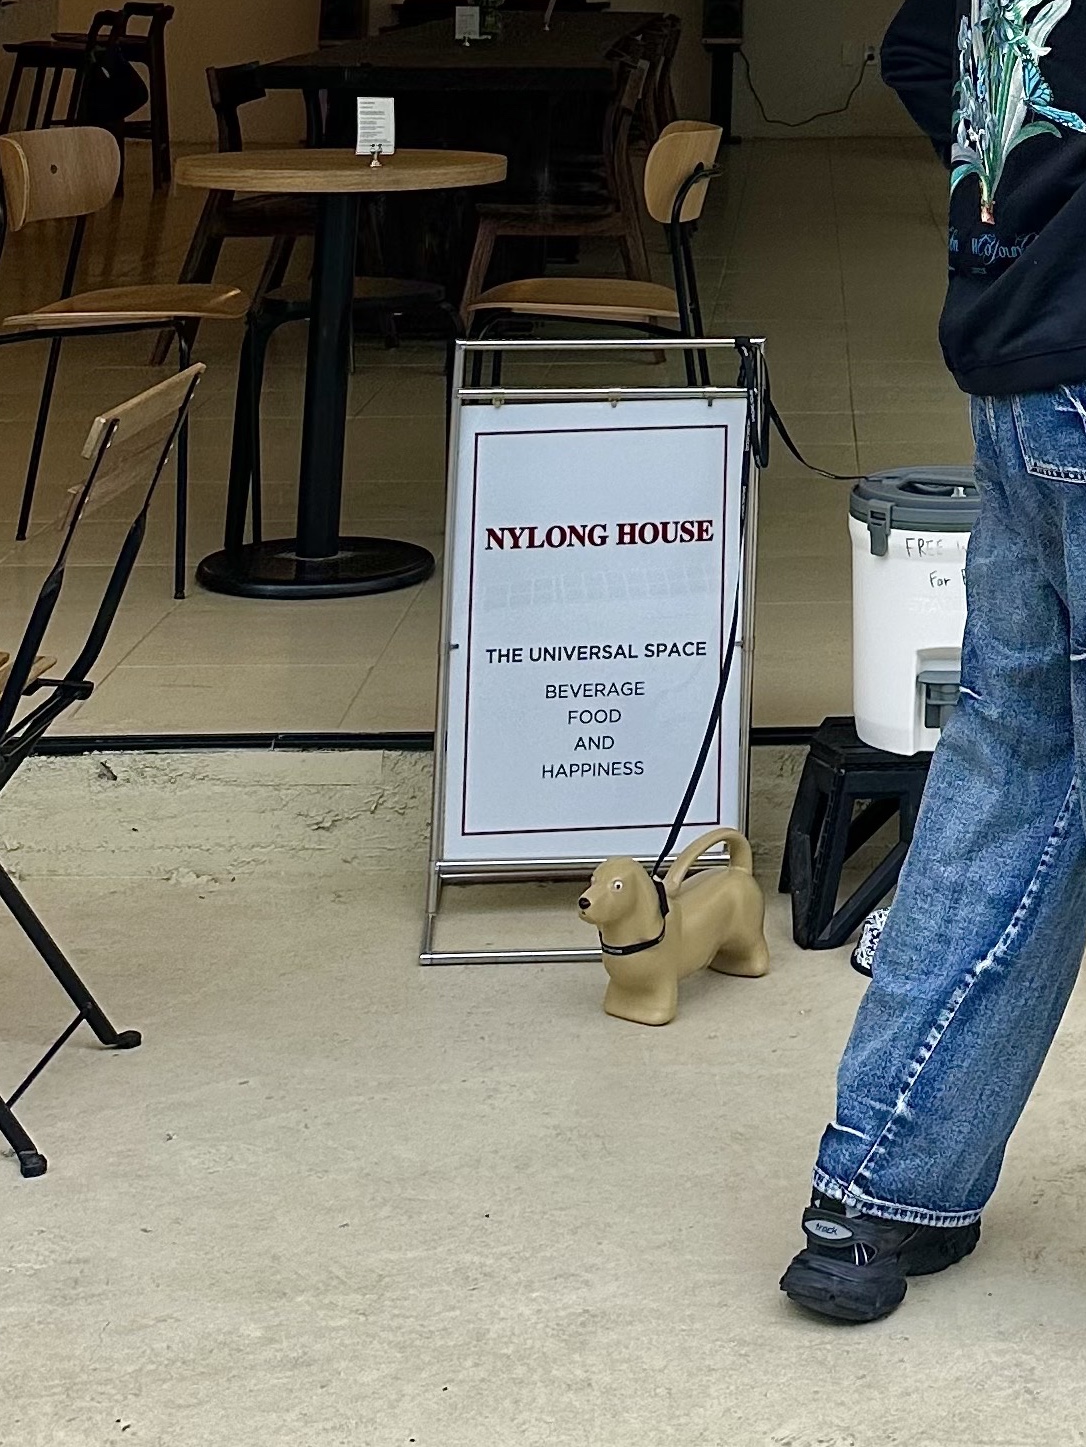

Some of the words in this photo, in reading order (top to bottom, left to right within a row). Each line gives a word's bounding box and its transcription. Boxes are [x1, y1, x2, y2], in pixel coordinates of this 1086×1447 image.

[485, 523, 609, 550] NYLONG
[616, 519, 714, 545] HOUSE
[905, 537, 943, 557] FREE
[929, 570, 951, 588] For
[486, 648, 524, 664] THE
[529, 644, 639, 662] UNIVERSAL
[644, 641, 707, 658] SPACE
[545, 681, 645, 699] BEVERAGE
[567, 709, 622, 725] FOOD
[573, 736, 615, 751] AND
[542, 761, 645, 779] HAPPINESS
